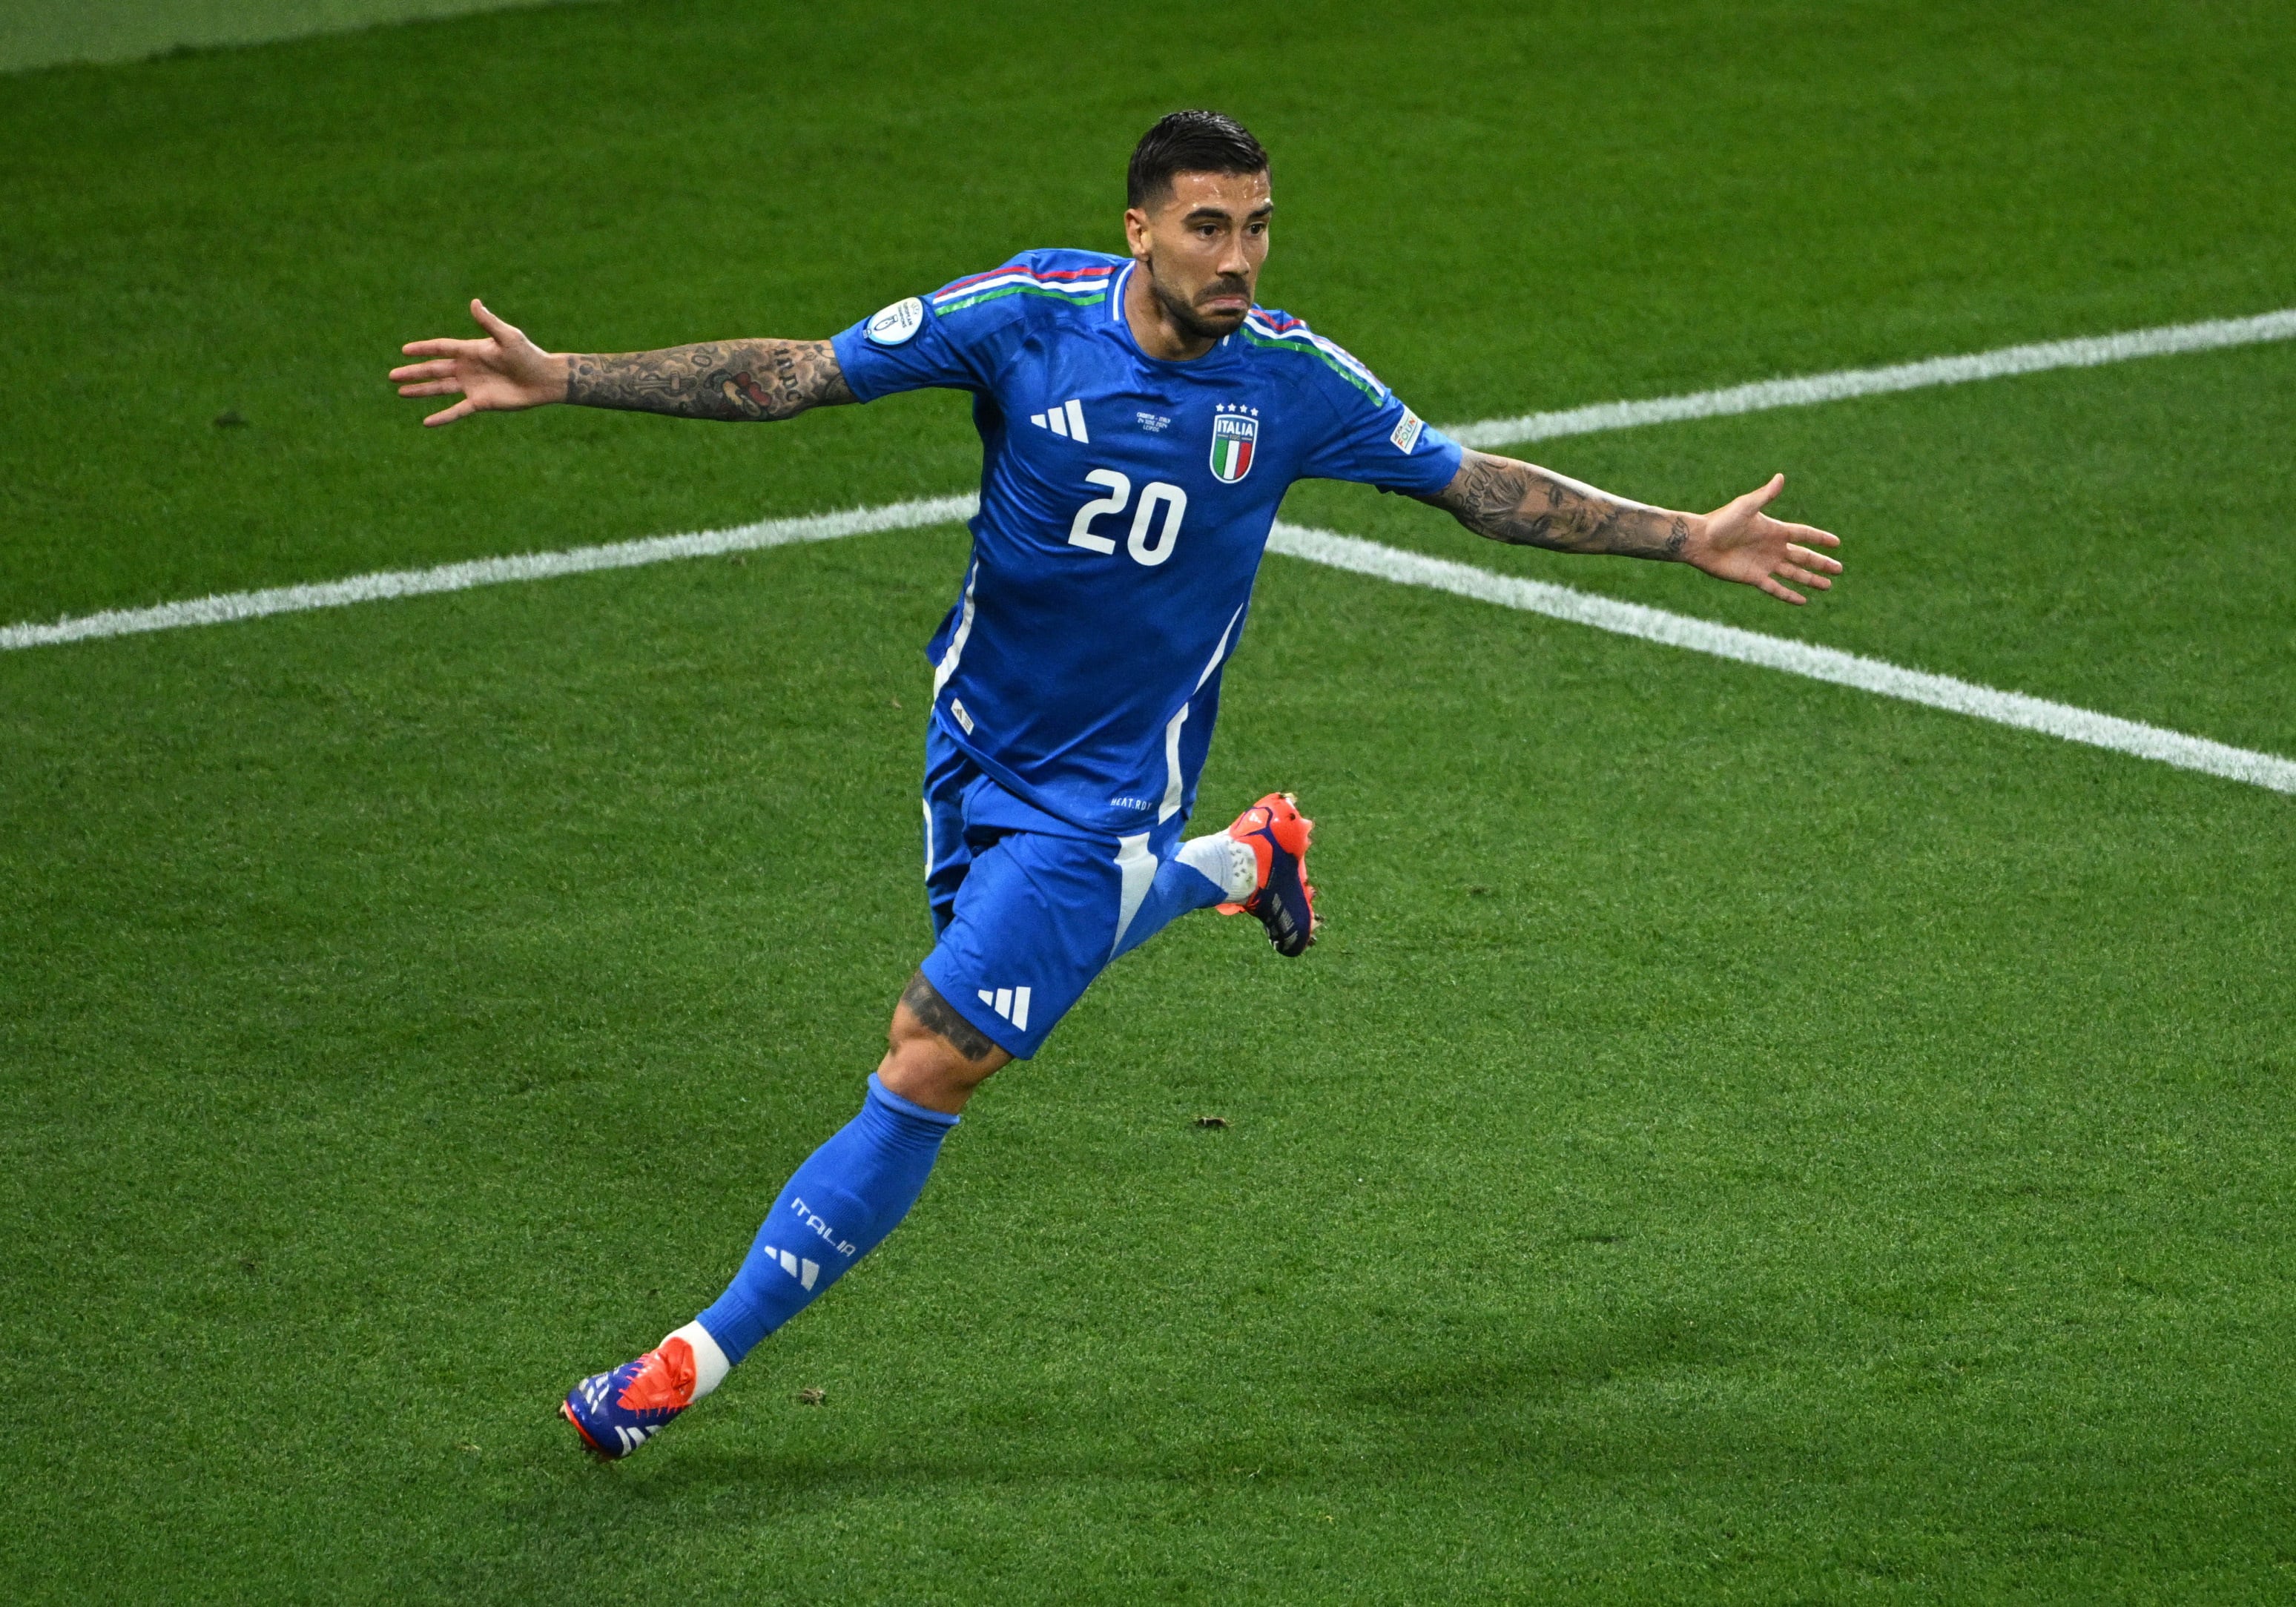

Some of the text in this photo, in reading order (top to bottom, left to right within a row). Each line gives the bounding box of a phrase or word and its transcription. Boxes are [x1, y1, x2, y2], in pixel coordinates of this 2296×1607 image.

[1217, 419, 1253, 437] ITALIA
[1068, 468, 1187, 567] 20
[1110, 797, 1152, 811] HEAT.RDY
[791, 1196, 857, 1258] ITALIA
